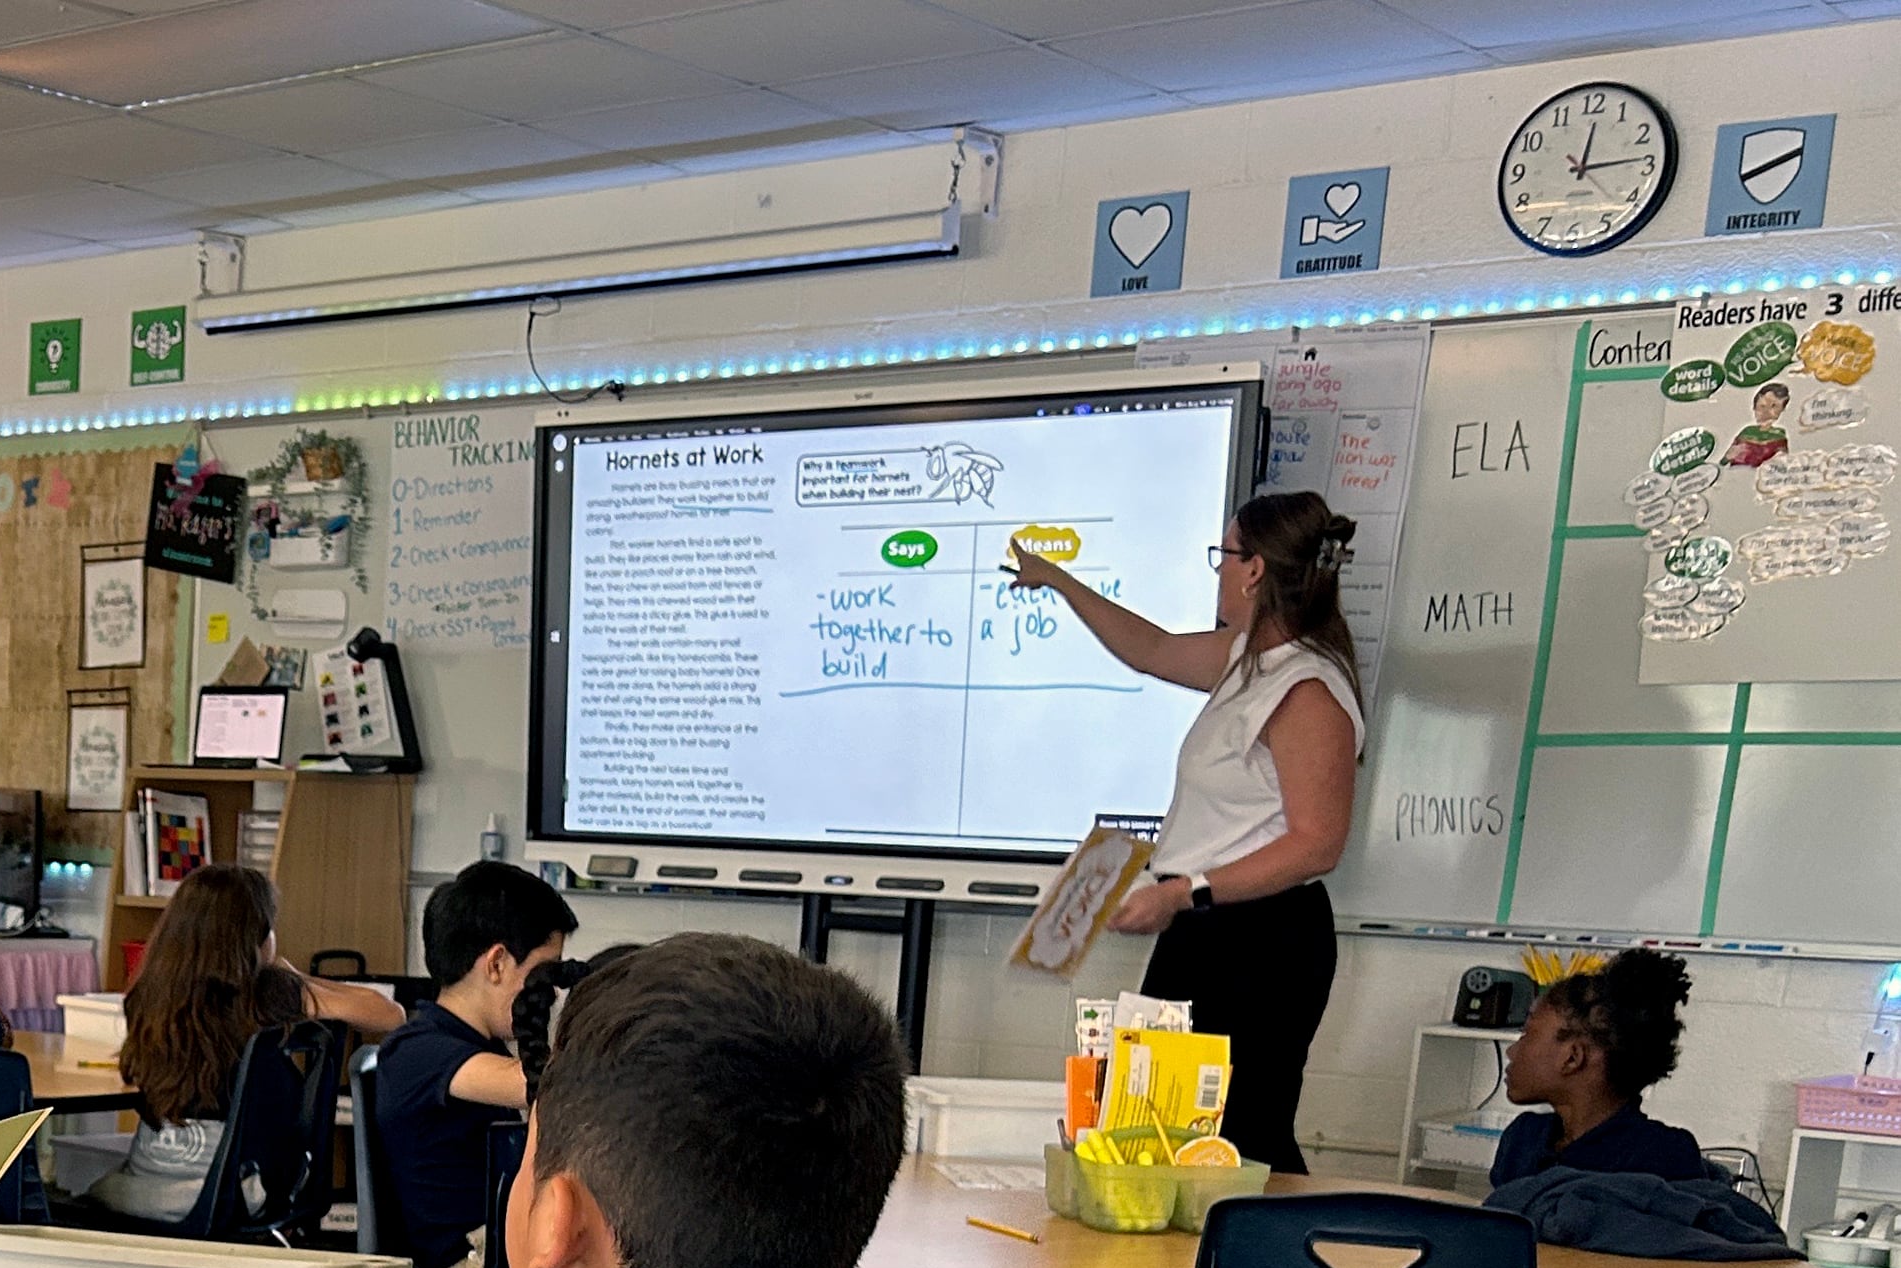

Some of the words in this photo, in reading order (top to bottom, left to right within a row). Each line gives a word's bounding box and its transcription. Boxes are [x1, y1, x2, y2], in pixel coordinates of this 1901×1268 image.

[1582, 92, 1606, 115] 12
[1617, 102, 1627, 123] 1
[1552, 105, 1570, 128] 11
[1522, 130, 1543, 153] 10
[1635, 123, 1651, 145] 2
[1510, 163, 1526, 185] 9
[1641, 155, 1656, 177] 3
[1626, 187, 1641, 208] 4
[1537, 217, 1553, 238] 7
[1599, 213, 1613, 234] 5
[1726, 209, 1802, 230] INTEGRITY
[1296, 253, 1363, 275] GRATITUDE
[1121, 276, 1148, 292] LOVE
[1678, 303, 1756, 329] Readers
[1760, 298, 1807, 322] have
[1825, 292, 1843, 316] 3
[1858, 287, 1901, 314] diffe
[1589, 328, 1672, 369] Conten
[1729, 335, 1791, 383] VOICE
[1810, 345, 1866, 371] VOICE
[1675, 364, 1713, 382] word
[1668, 378, 1719, 396] details
[394, 413, 480, 448] BEHAVIOR
[606, 449, 680, 472] Hornets
[686, 447, 706, 467] at
[712, 442, 765, 465] Work
[1452, 419, 1530, 479] ELA
[887, 541, 926, 559] Says
[1018, 536, 1074, 554] Means
[1424, 591, 1514, 632] MATH
[810, 613, 916, 656] together
[920, 617, 953, 647] to
[981, 619, 994, 640] a
[1009, 608, 1058, 656] job
[821, 649, 888, 680] build
[1396, 791, 1505, 842] PHONICS
